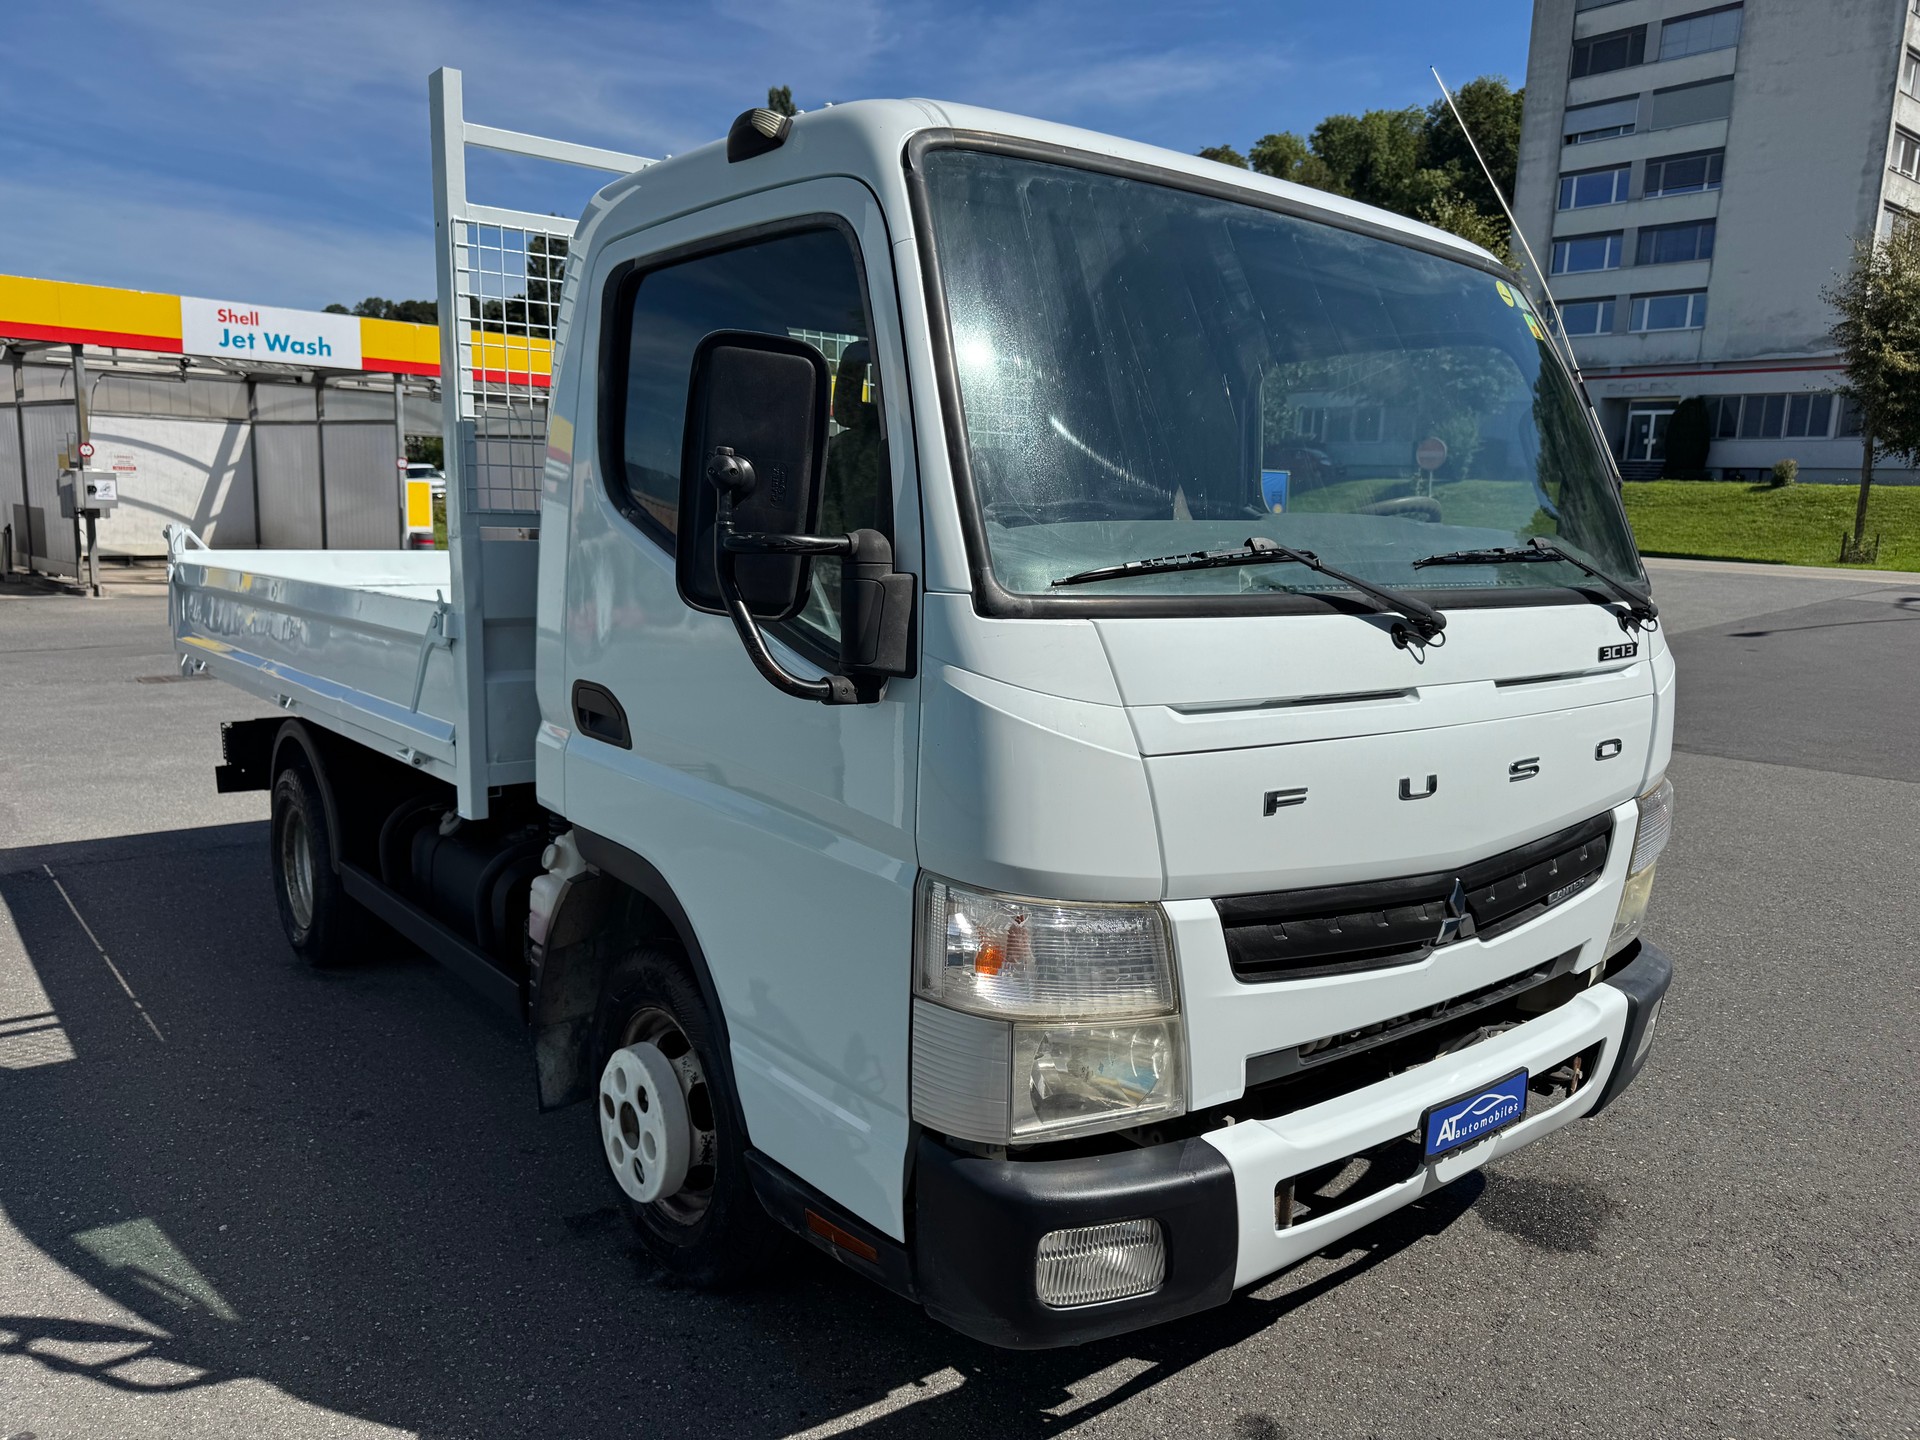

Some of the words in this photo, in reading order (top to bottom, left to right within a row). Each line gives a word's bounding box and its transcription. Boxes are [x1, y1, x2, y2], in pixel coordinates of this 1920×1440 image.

[217, 308, 259, 326] Shell
[218, 328, 256, 350] Jet
[263, 331, 332, 357] Wash
[1603, 644, 1634, 660] 3C13
[1263, 738, 1622, 817] FUSO
[1455, 1102, 1519, 1139] automobiles
